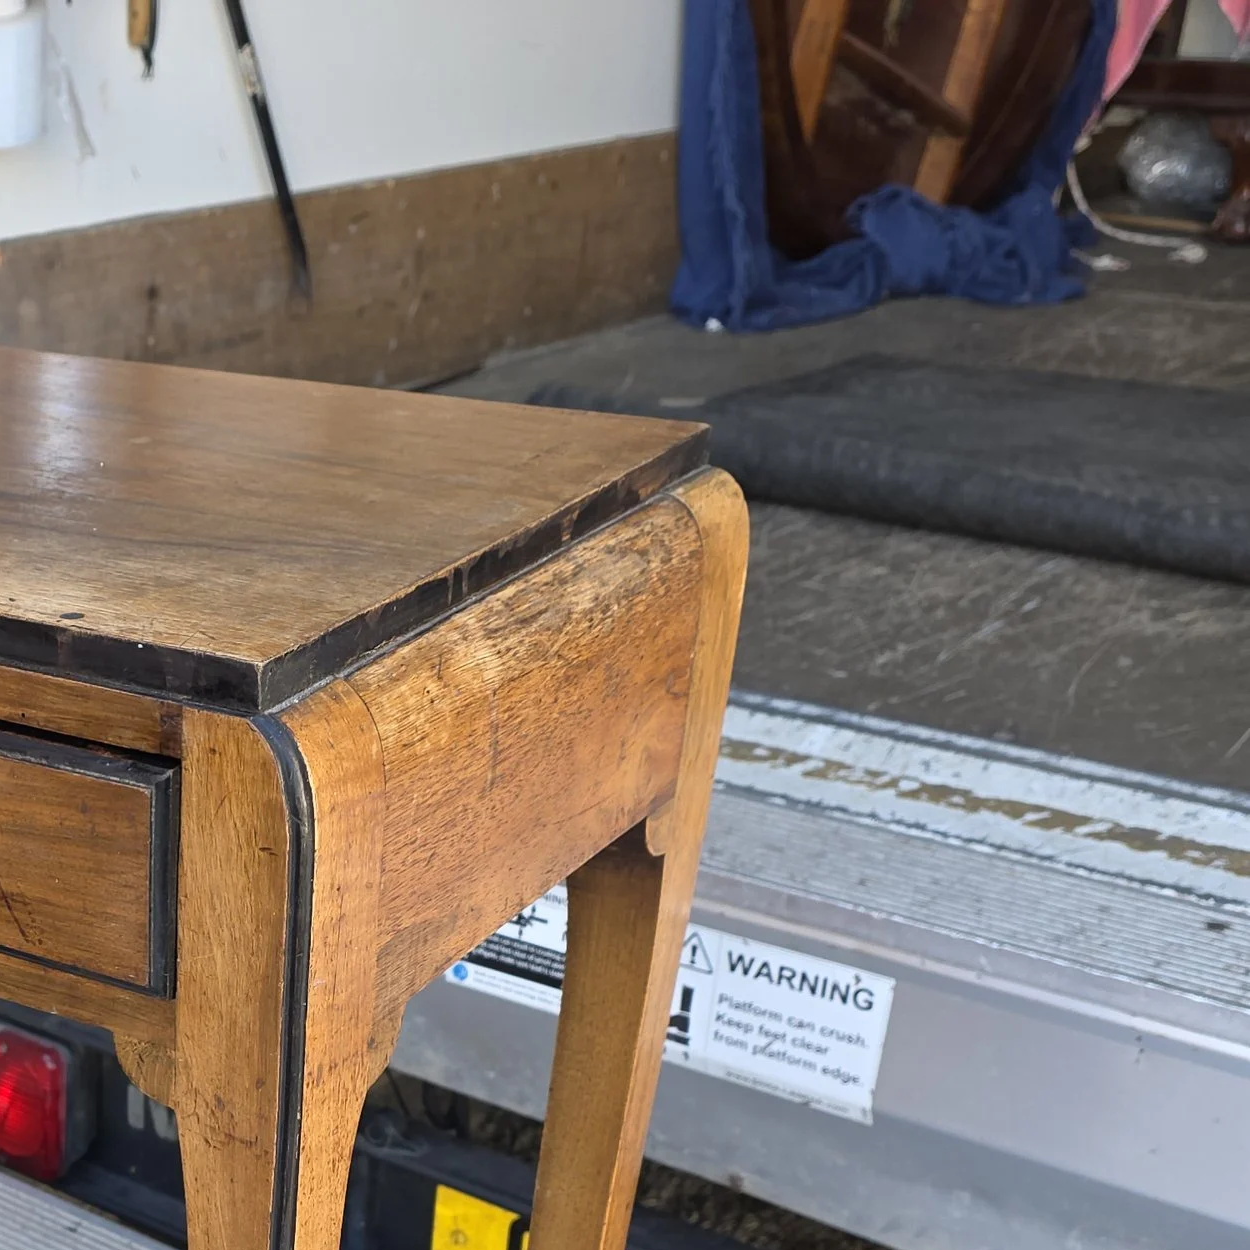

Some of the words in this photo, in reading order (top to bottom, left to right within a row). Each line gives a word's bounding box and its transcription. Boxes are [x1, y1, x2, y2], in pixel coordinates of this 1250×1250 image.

[727, 950, 874, 1011] WARNING
[715, 1011, 754, 1034] Keep
[758, 1023, 786, 1043] feet
[791, 1035, 829, 1055] clear
[718, 992, 783, 1022] Platform
[786, 1015, 815, 1032] can
[713, 1029, 748, 1050] from
[751, 1043, 817, 1071] platform
